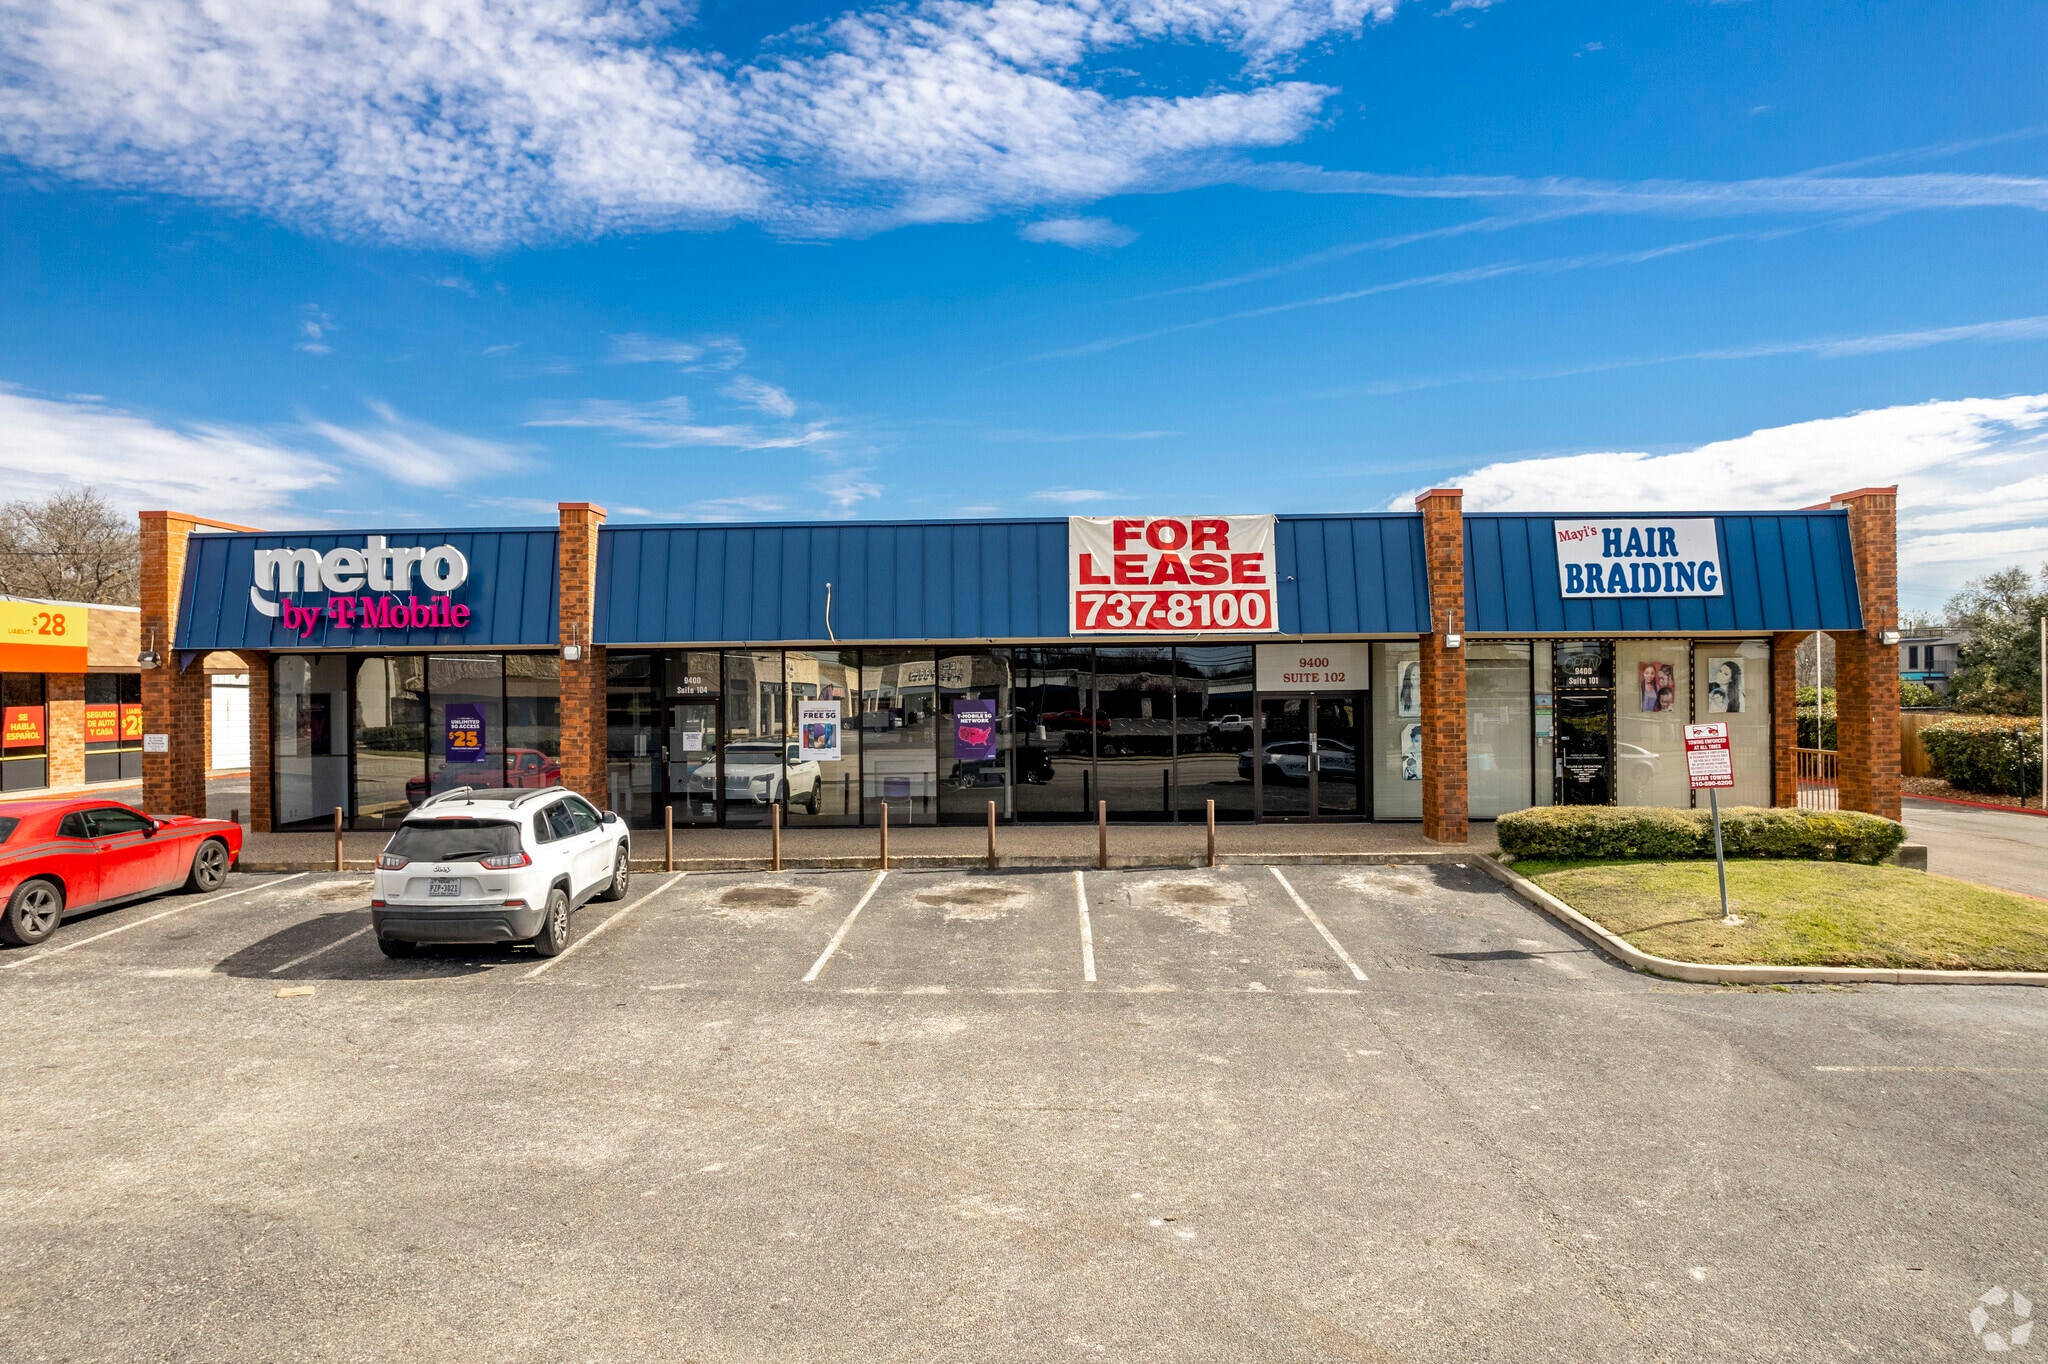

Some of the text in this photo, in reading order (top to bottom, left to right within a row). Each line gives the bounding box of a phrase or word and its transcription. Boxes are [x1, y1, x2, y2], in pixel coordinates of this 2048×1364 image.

[1113, 520, 1230, 551] FOR
[1558, 526, 1679, 557] Mayi's HAIR
[251, 535, 468, 602] metro
[1079, 553, 1266, 585] LEASE
[1564, 561, 1718, 593] BRAIDING
[282, 598, 322, 638] by
[1080, 592, 1266, 628] 737-8100
[1299, 658, 1329, 667] 9400
[1283, 672, 1346, 683] SUITE 102
[10, 722, 36, 730] HABLA
[86, 710, 116, 719] SEGUROS
[98, 719, 115, 727] AUTO
[6, 730, 40, 740] ESPAÑOL
[449, 731, 478, 746] $25
